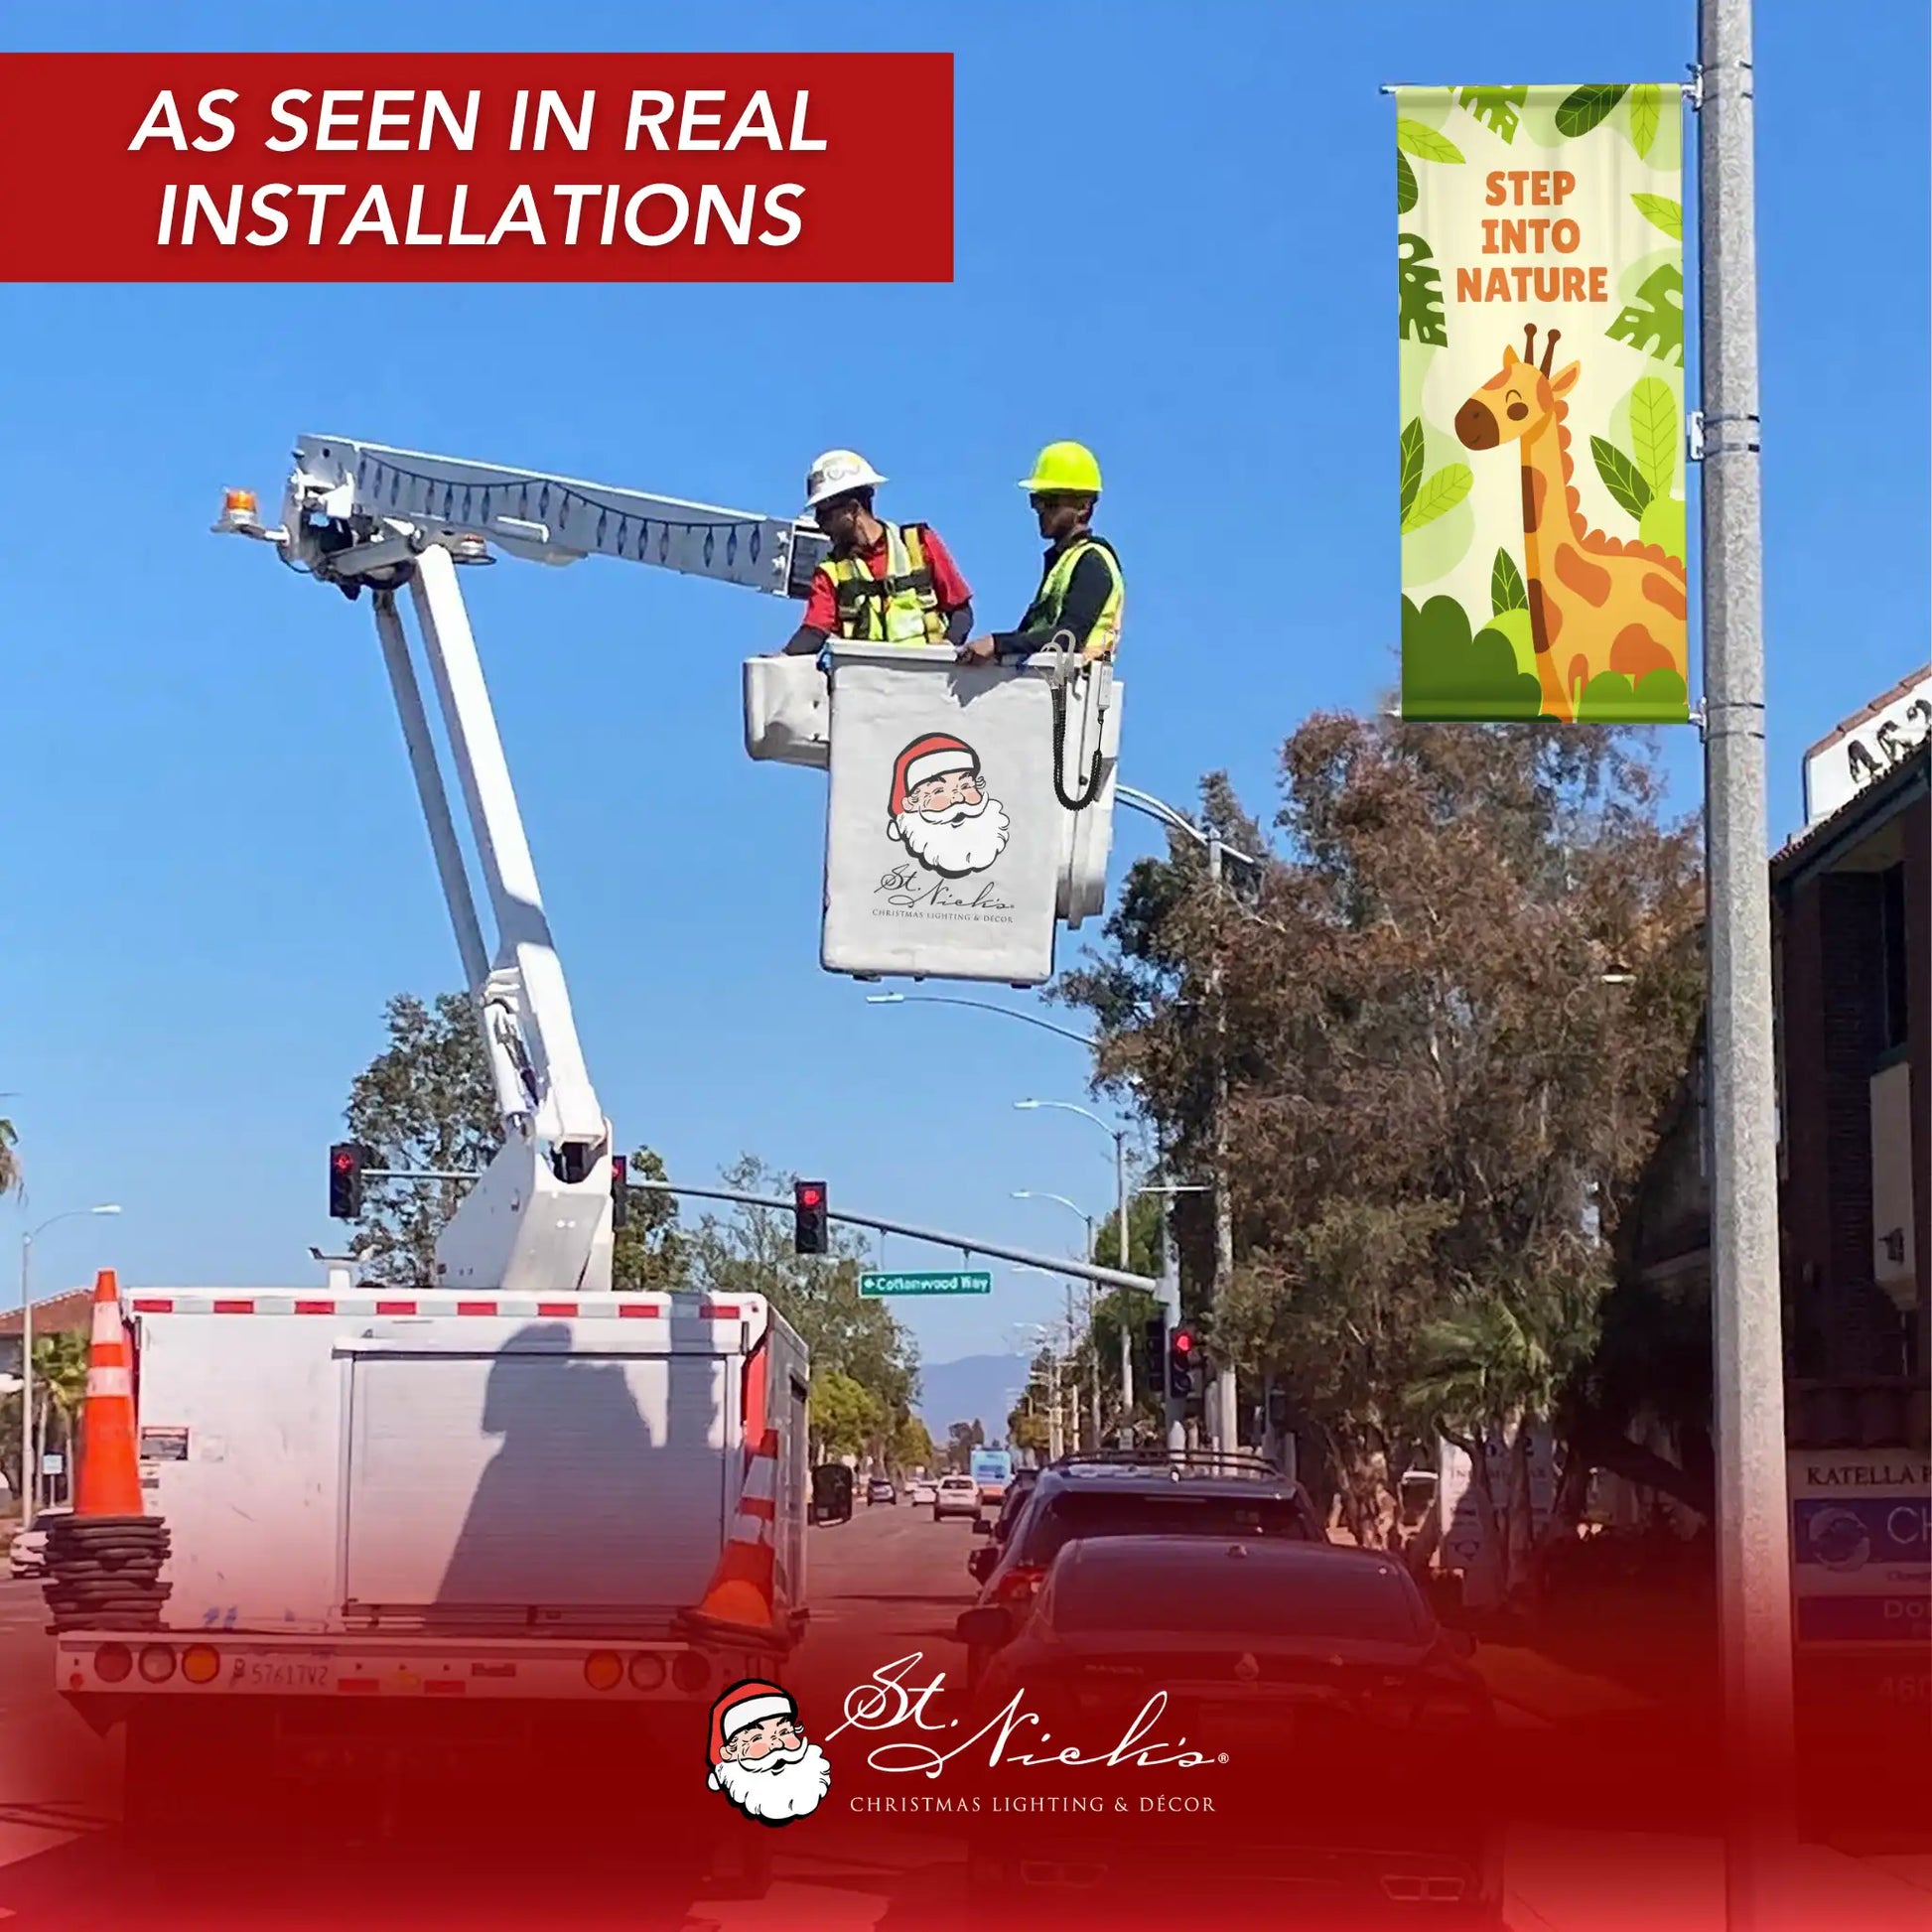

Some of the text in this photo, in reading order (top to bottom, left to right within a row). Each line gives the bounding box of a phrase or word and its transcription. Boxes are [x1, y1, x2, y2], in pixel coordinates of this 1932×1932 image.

[1486, 171, 1575, 206] STEP
[1482, 218, 1580, 253] INTO
[1457, 267, 1607, 302] NATURE
[874, 864, 920, 893] St.
[872, 908, 923, 918] CHRISTMAS
[926, 911, 971, 921] LIGHTING
[877, 1276, 989, 1292] Cottonwood Way
[1807, 1465, 1915, 1485] KATELLA
